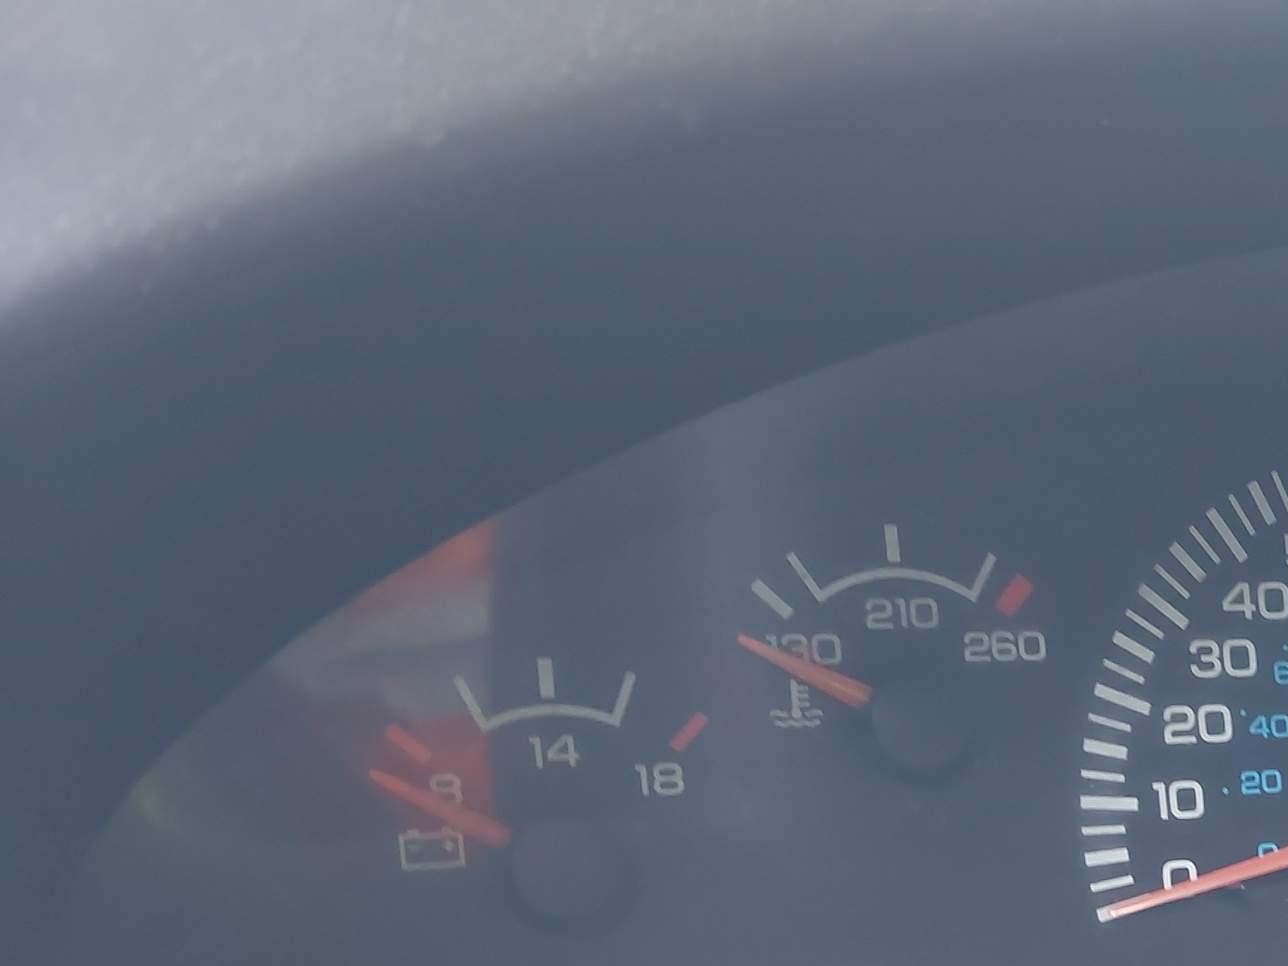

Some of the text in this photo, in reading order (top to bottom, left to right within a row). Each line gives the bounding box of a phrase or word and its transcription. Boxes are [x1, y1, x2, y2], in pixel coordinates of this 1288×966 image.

[865, 597, 938, 631] 210
[964, 632, 1046, 662] 260
[1190, 639, 1257, 679] 30
[1163, 703, 1232, 744] 20
[528, 735, 579, 769] 14
[635, 763, 684, 796] 18
[1240, 770, 1282, 794] 20
[1153, 780, 1204, 820] 10
